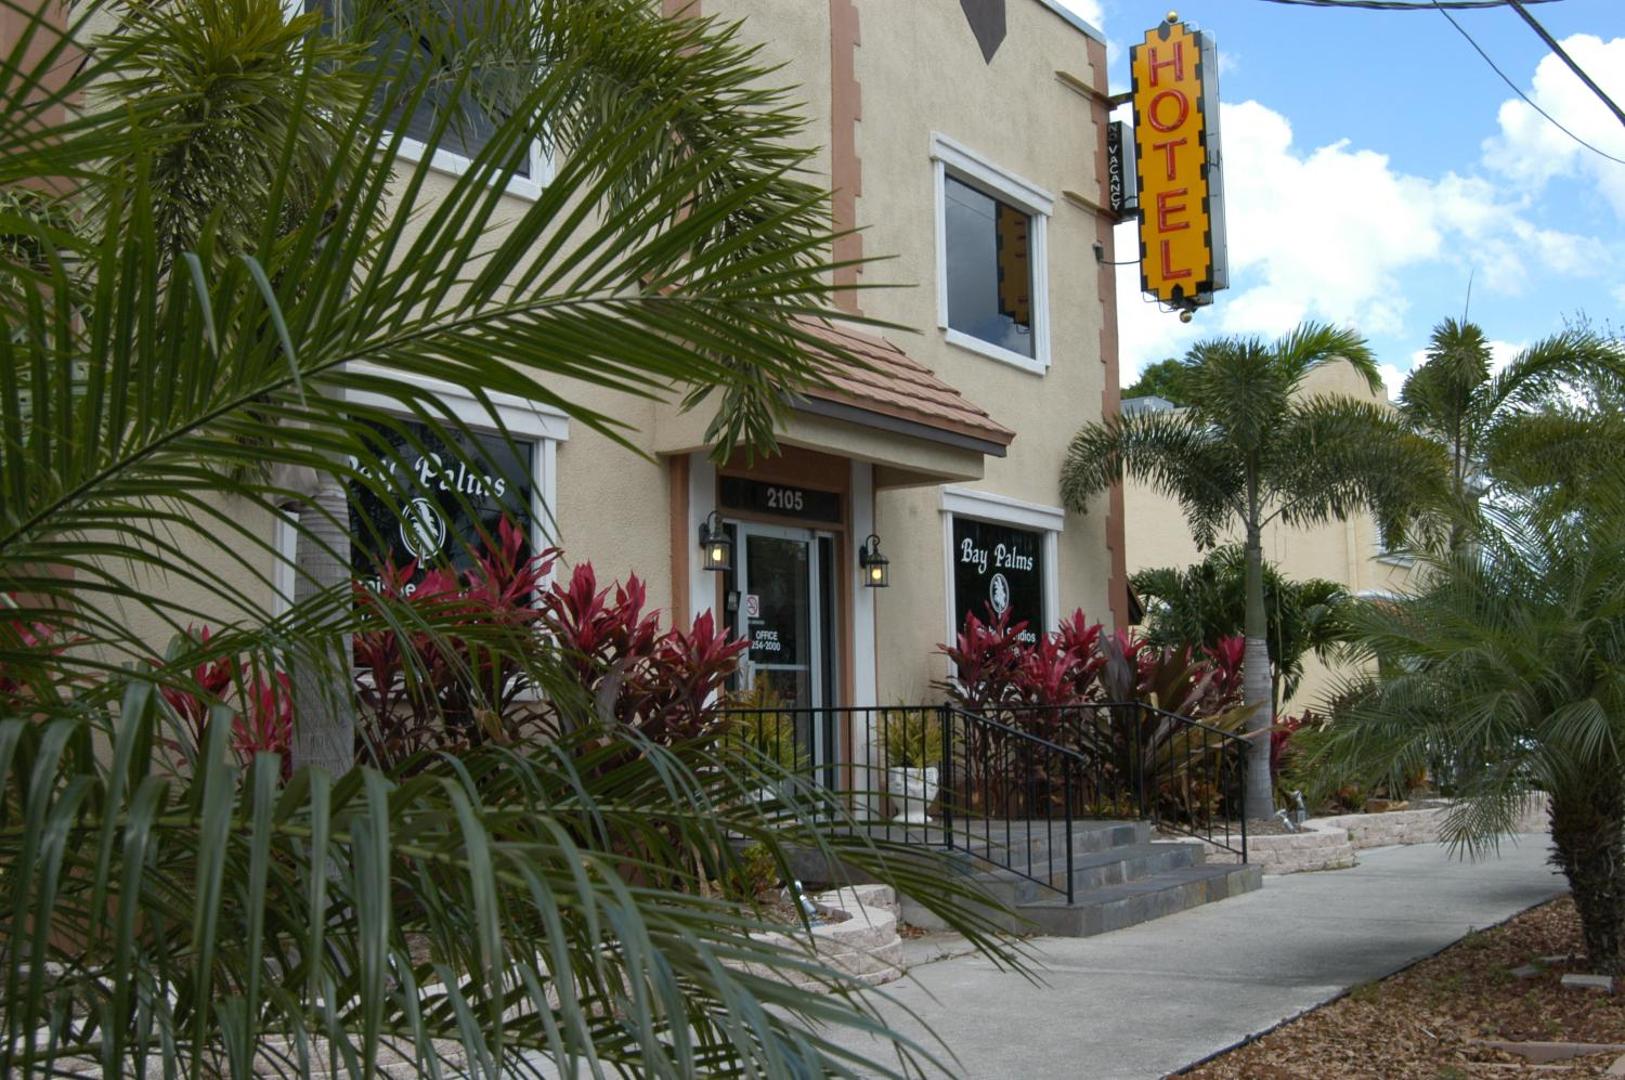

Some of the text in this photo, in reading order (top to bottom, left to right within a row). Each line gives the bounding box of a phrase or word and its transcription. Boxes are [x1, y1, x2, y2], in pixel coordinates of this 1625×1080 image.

[1108, 144, 1121, 211] VACANCY
[1147, 40, 1192, 281] HOTEL
[414, 452, 507, 498] Palms
[767, 487, 803, 511] 2105
[960, 537, 1034, 574] Bay Palms
[751, 640, 781, 651] 254-2000
[756, 630, 779, 641] OFFICE
